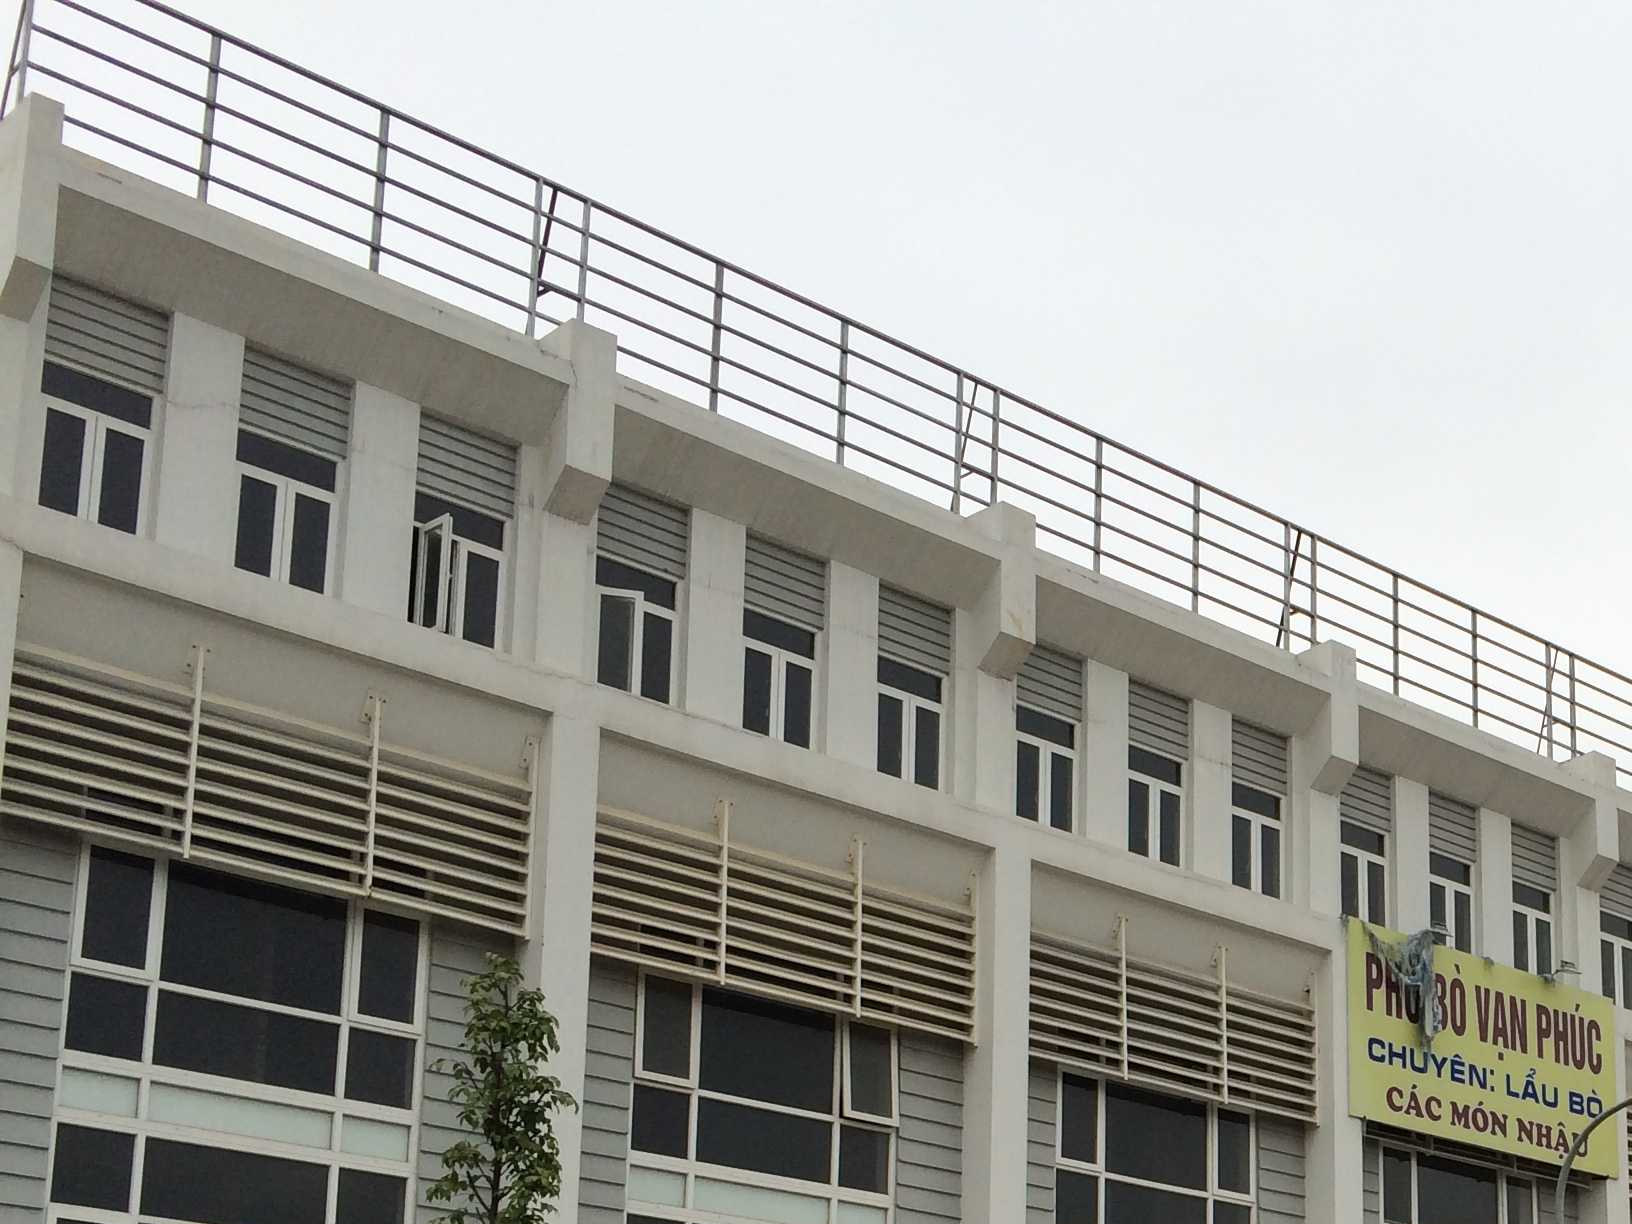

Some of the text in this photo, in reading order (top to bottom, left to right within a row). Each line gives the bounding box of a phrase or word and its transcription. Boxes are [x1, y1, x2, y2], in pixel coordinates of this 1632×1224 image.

[1434, 963, 1467, 1037] BÒ
[1475, 984, 1529, 1062] VẠN
[1536, 1003, 1603, 1075] PHÚC
[1367, 1037, 1603, 1119] CHUYÊN: LẨU BÒ
[1386, 1085, 1443, 1121] CÁC
[1450, 1101, 1508, 1138] MÓN
